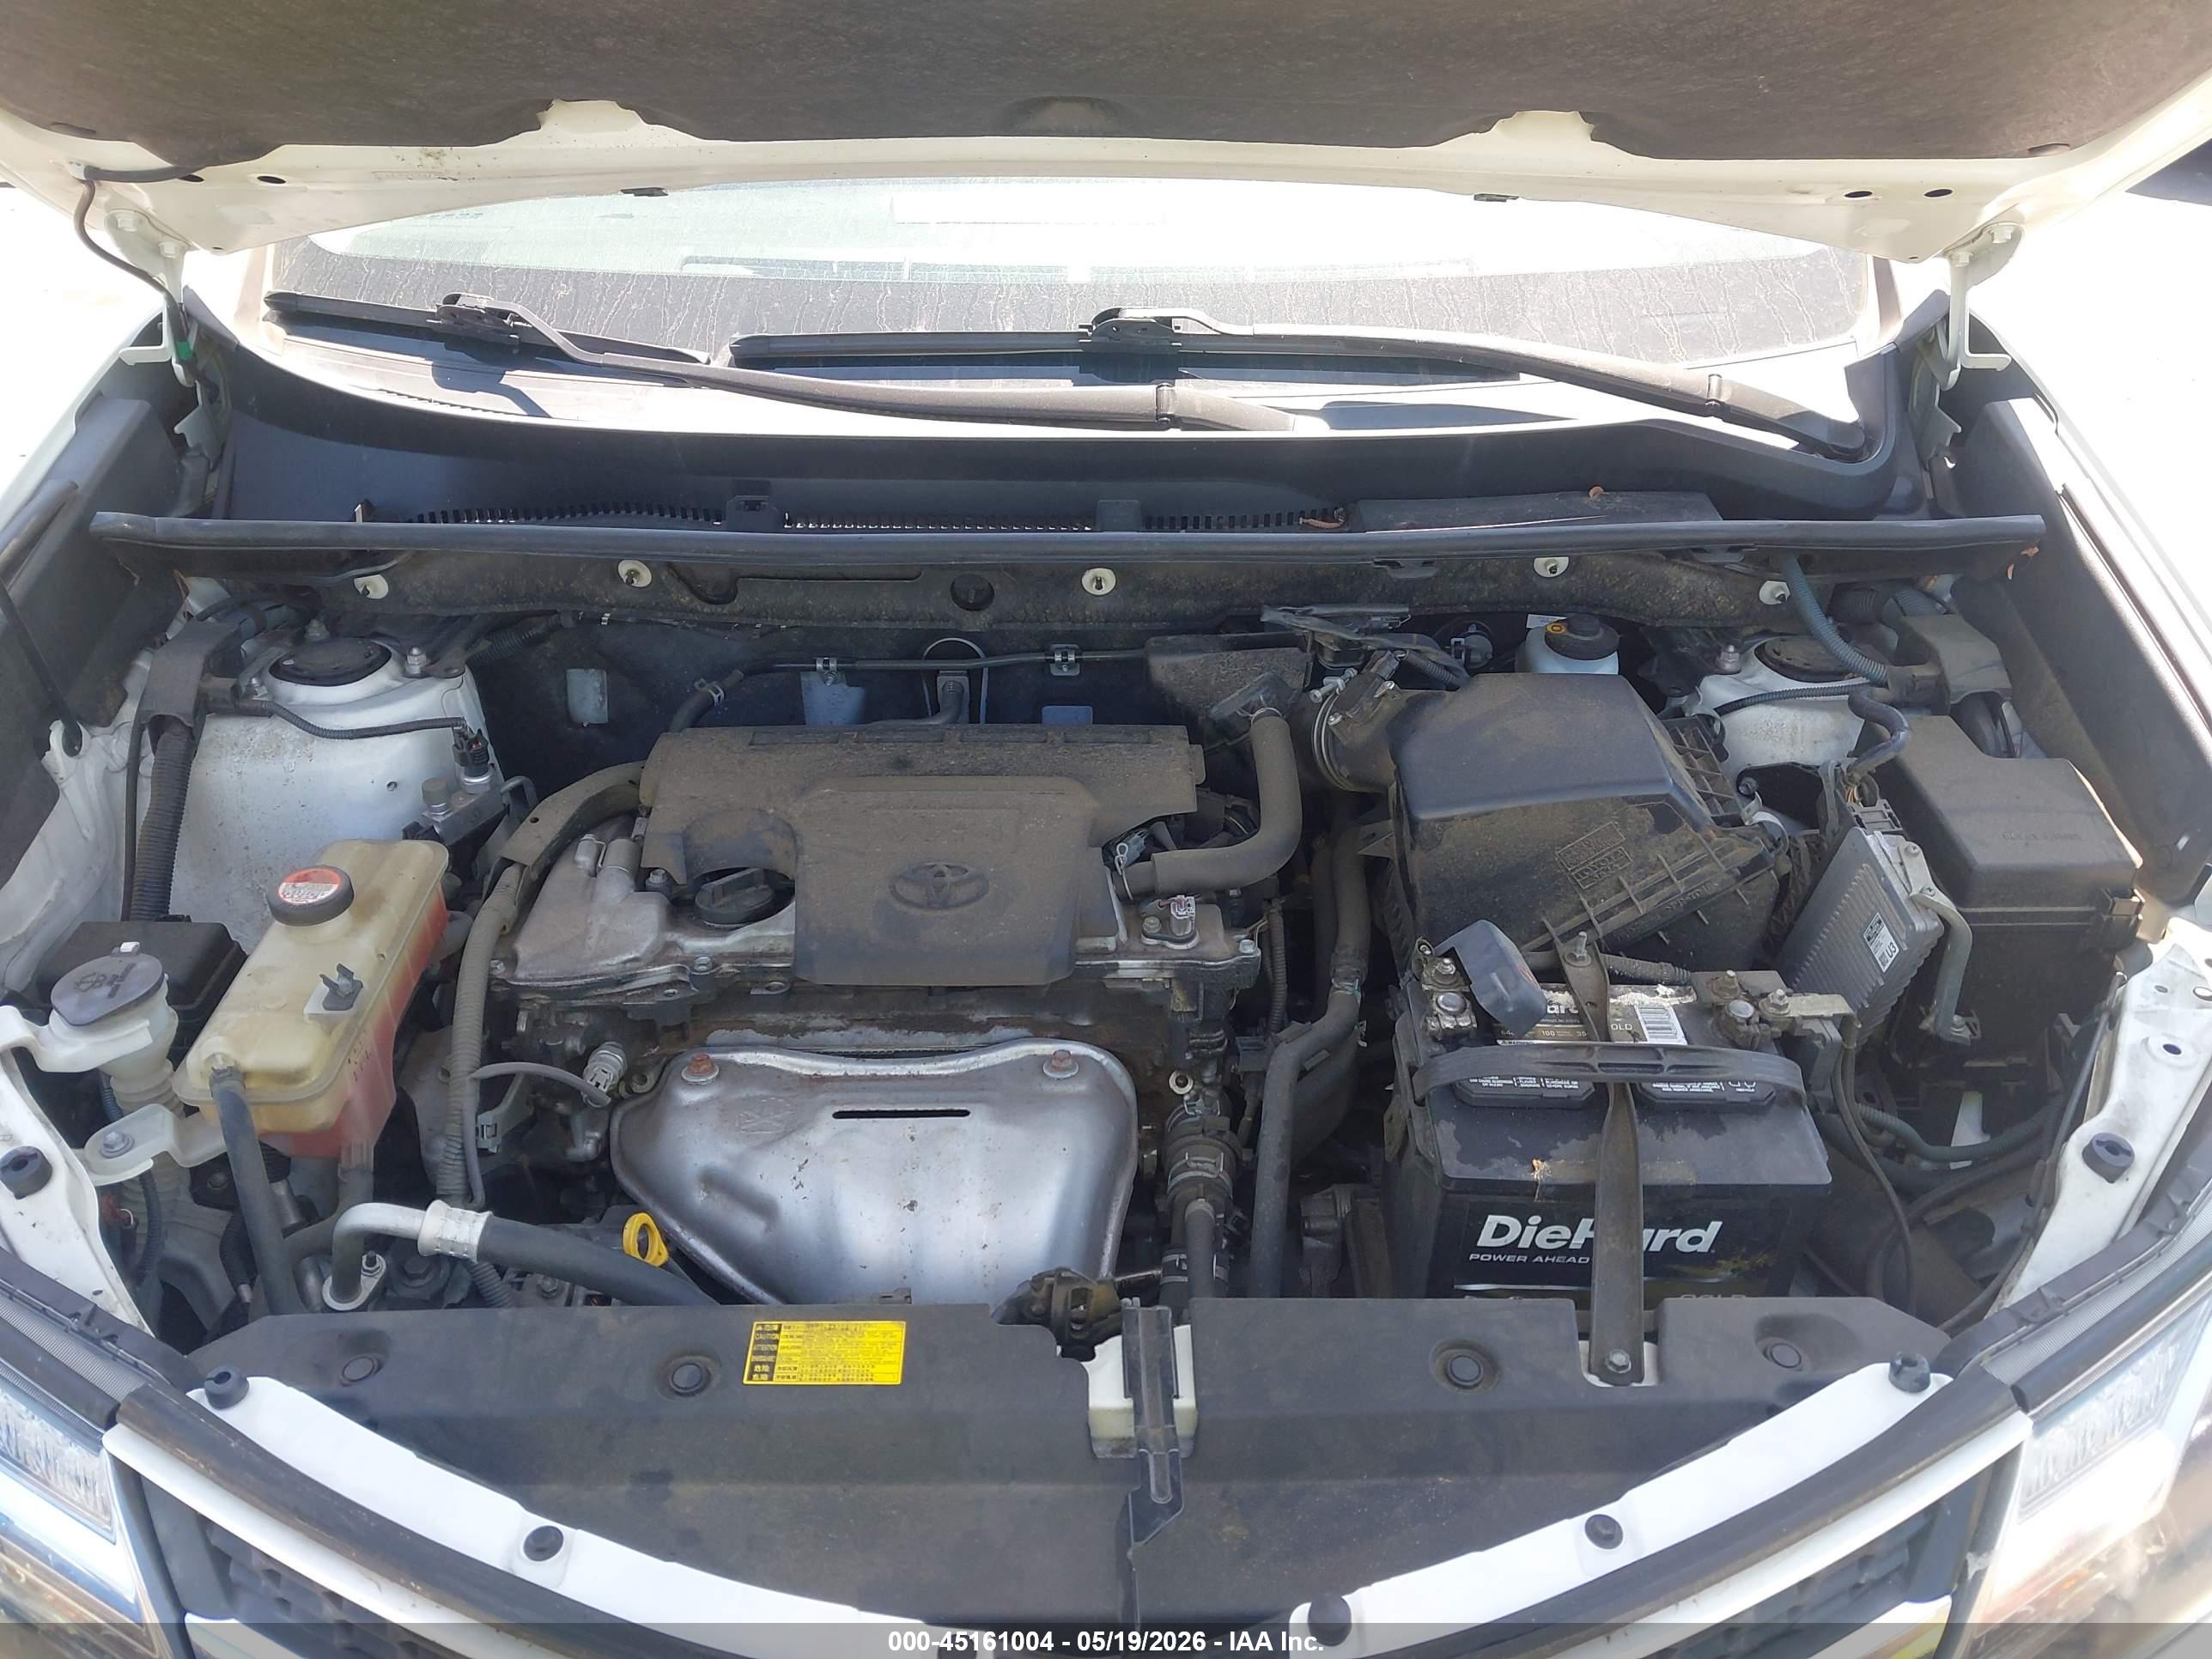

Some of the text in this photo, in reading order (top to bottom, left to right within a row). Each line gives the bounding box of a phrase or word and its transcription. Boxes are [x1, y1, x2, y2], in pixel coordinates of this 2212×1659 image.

[1885, 941, 1897, 958] U3
[1610, 1023, 1633, 1031] OLD
[1468, 1253, 1590, 1264] POWER AHEAD
